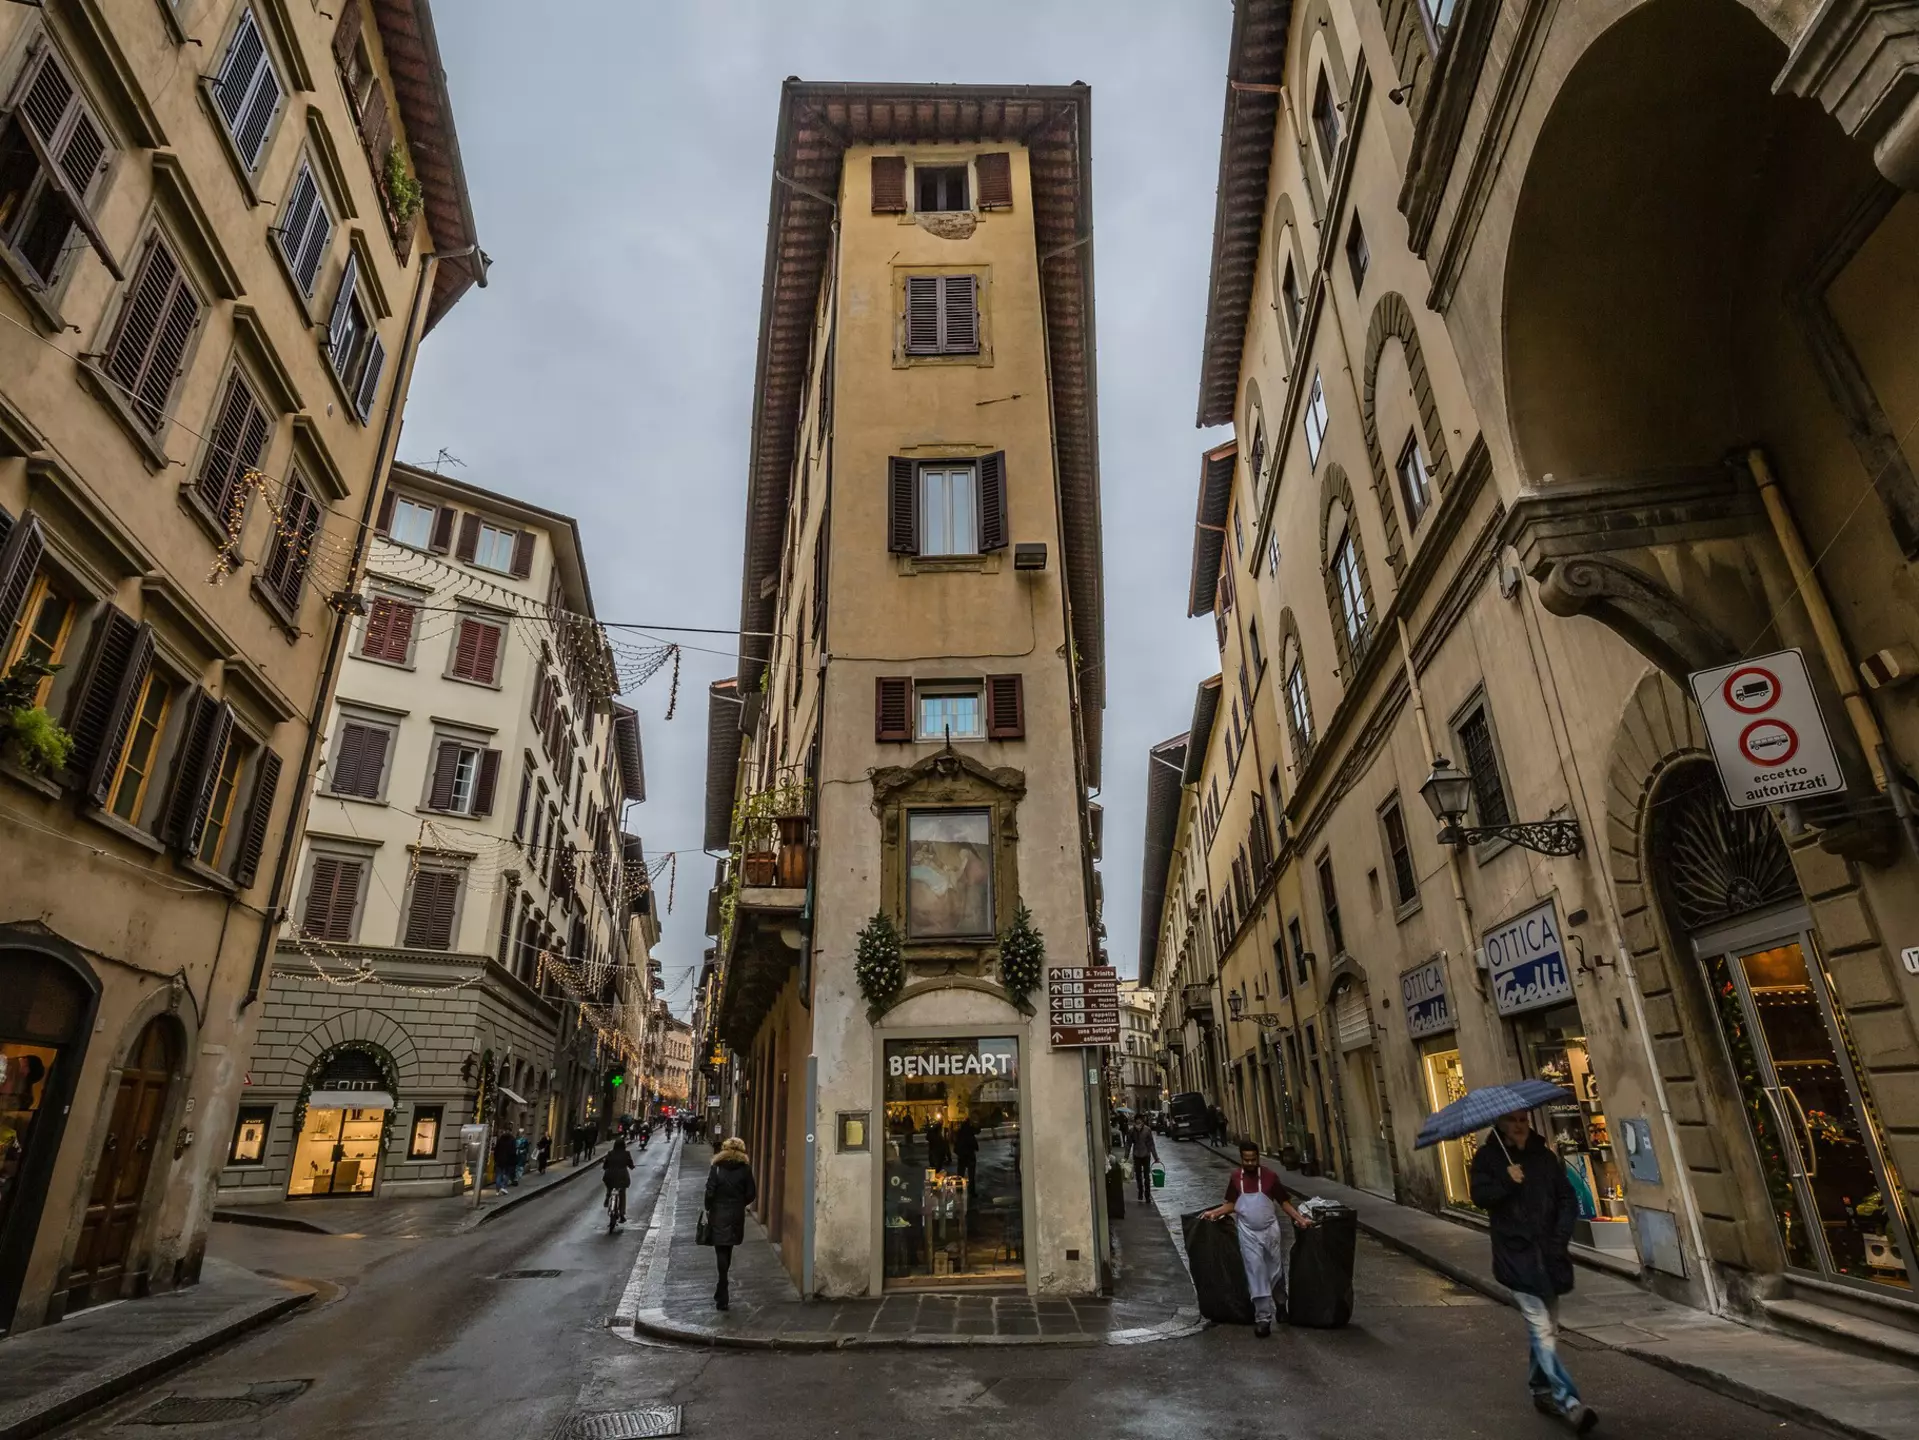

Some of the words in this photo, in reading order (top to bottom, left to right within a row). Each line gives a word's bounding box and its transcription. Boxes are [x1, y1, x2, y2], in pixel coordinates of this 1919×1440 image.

[1745, 774, 1828, 801] autorizzati
[1753, 766, 1808, 784] eccetto
[1488, 915, 1557, 967] OTTICA
[1403, 966, 1444, 1000] OTTICA
[1495, 962, 1567, 1009] Torelli
[889, 1053, 1011, 1076] BENHEART
